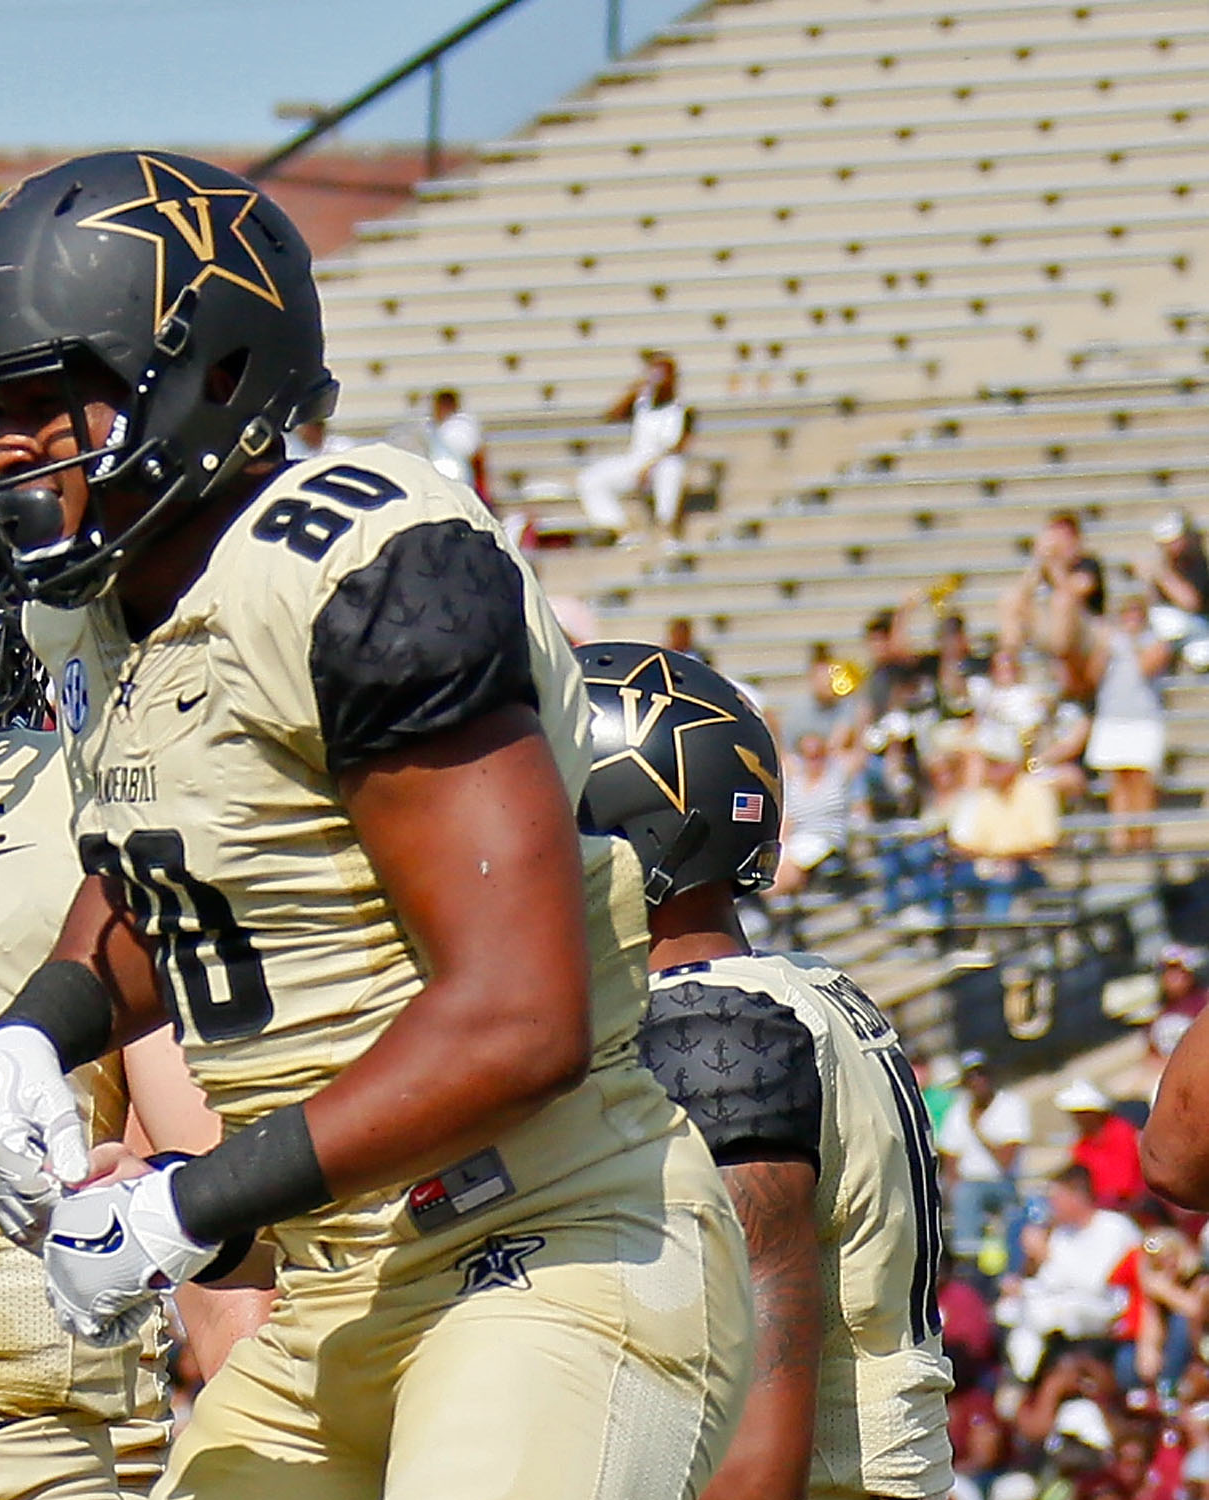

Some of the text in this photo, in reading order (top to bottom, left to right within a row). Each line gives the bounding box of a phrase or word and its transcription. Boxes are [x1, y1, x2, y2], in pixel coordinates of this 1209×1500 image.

[155, 196, 215, 262] V
[251, 464, 407, 563] 80
[618, 686, 672, 748] V
